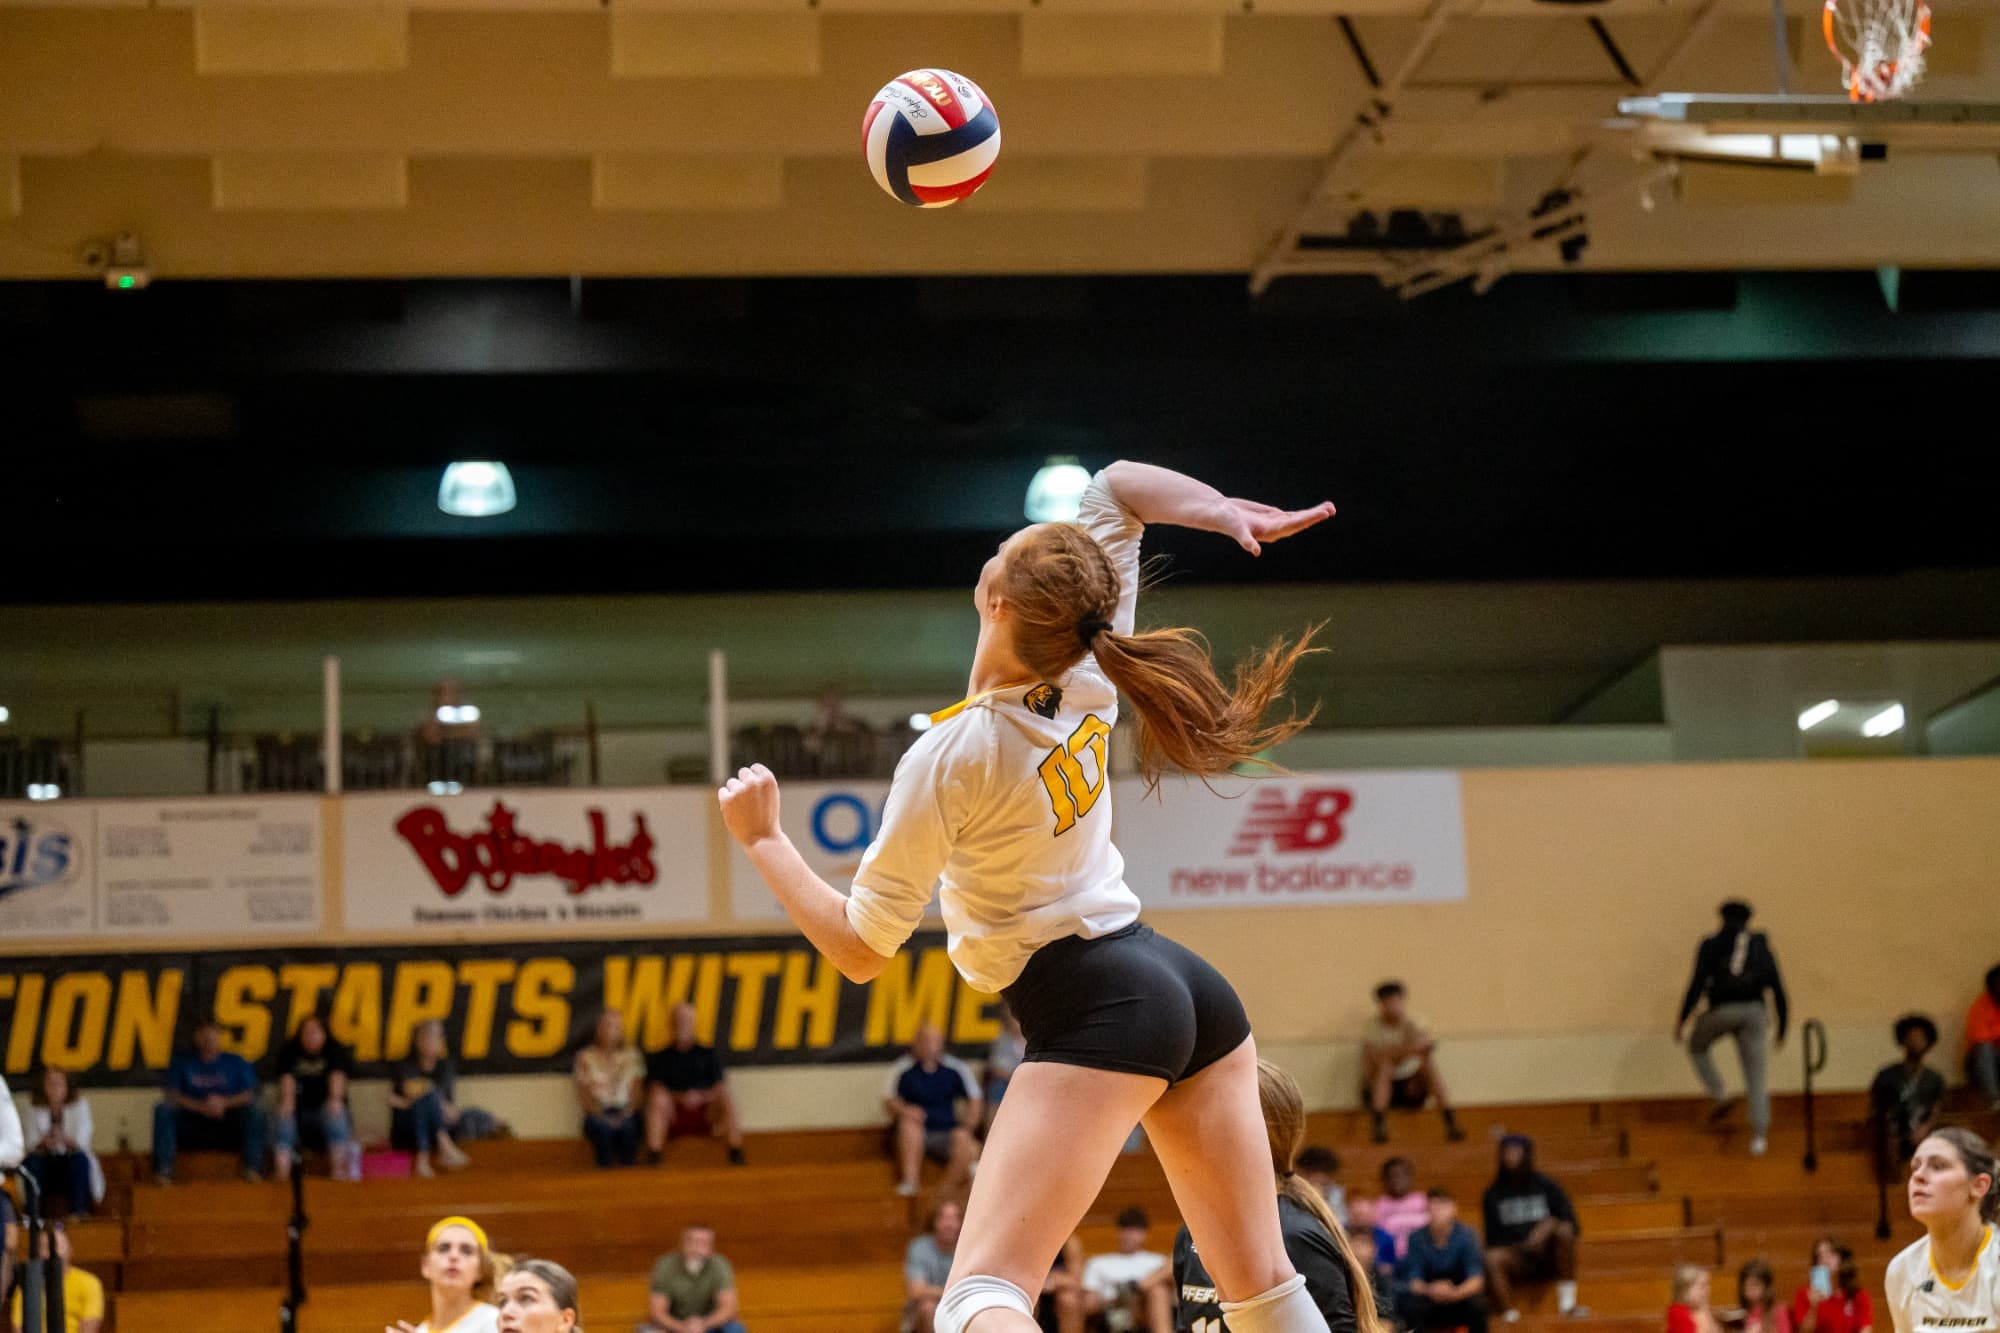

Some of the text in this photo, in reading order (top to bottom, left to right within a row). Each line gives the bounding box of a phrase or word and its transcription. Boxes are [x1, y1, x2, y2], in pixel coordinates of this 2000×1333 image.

[1037, 713, 1111, 837] 10
[1170, 861, 1415, 895] new balance
[0, 969, 184, 1074] ION
[603, 951, 843, 1053] WITH
